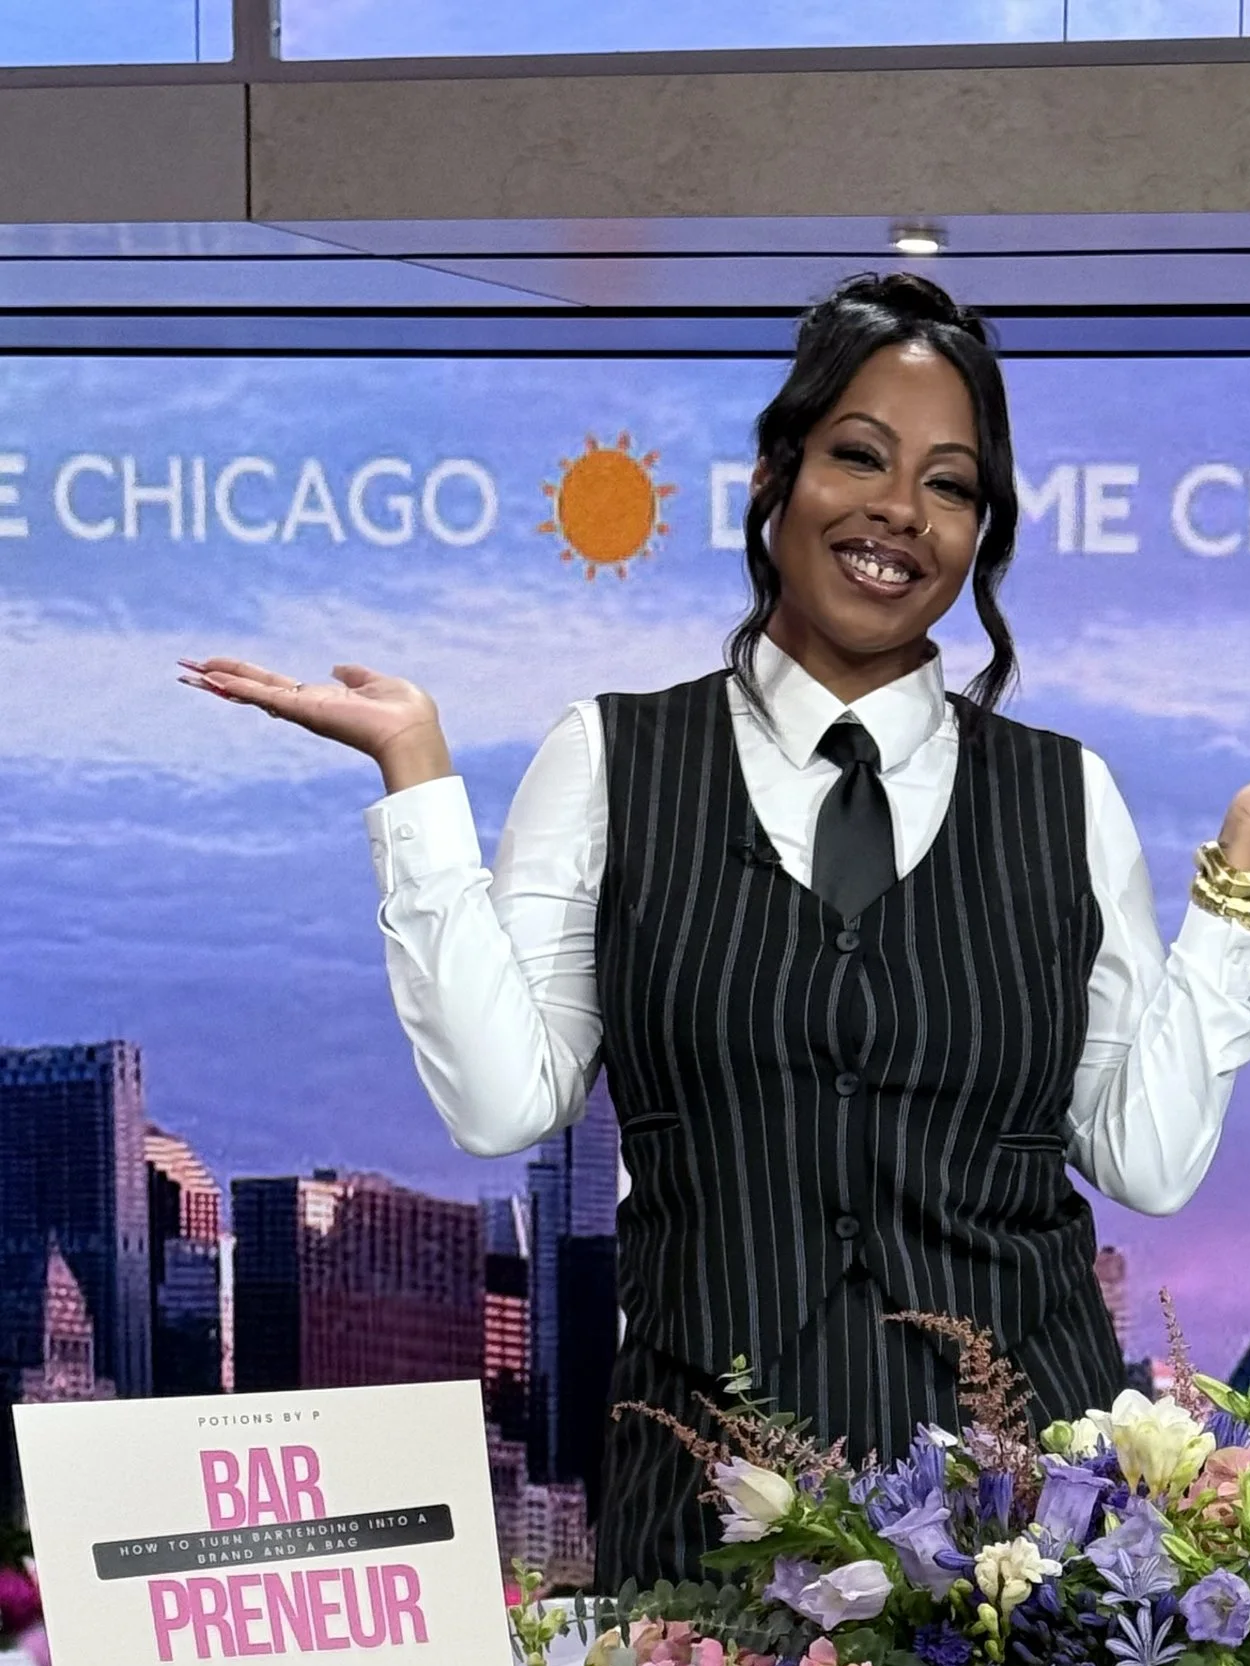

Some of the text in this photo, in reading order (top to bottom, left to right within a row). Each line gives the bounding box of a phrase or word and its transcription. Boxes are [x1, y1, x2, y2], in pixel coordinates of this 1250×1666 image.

[54, 453, 499, 548] CHICAGO
[198, 1410, 320, 1427] POTIONS BY P
[199, 1444, 326, 1530] BAR
[120, 1513, 428, 1557] HOW TO TURN BARTENDING INTO A
[197, 1536, 359, 1565] BRAND AND A BAG
[147, 1564, 430, 1662] PRENEUR
